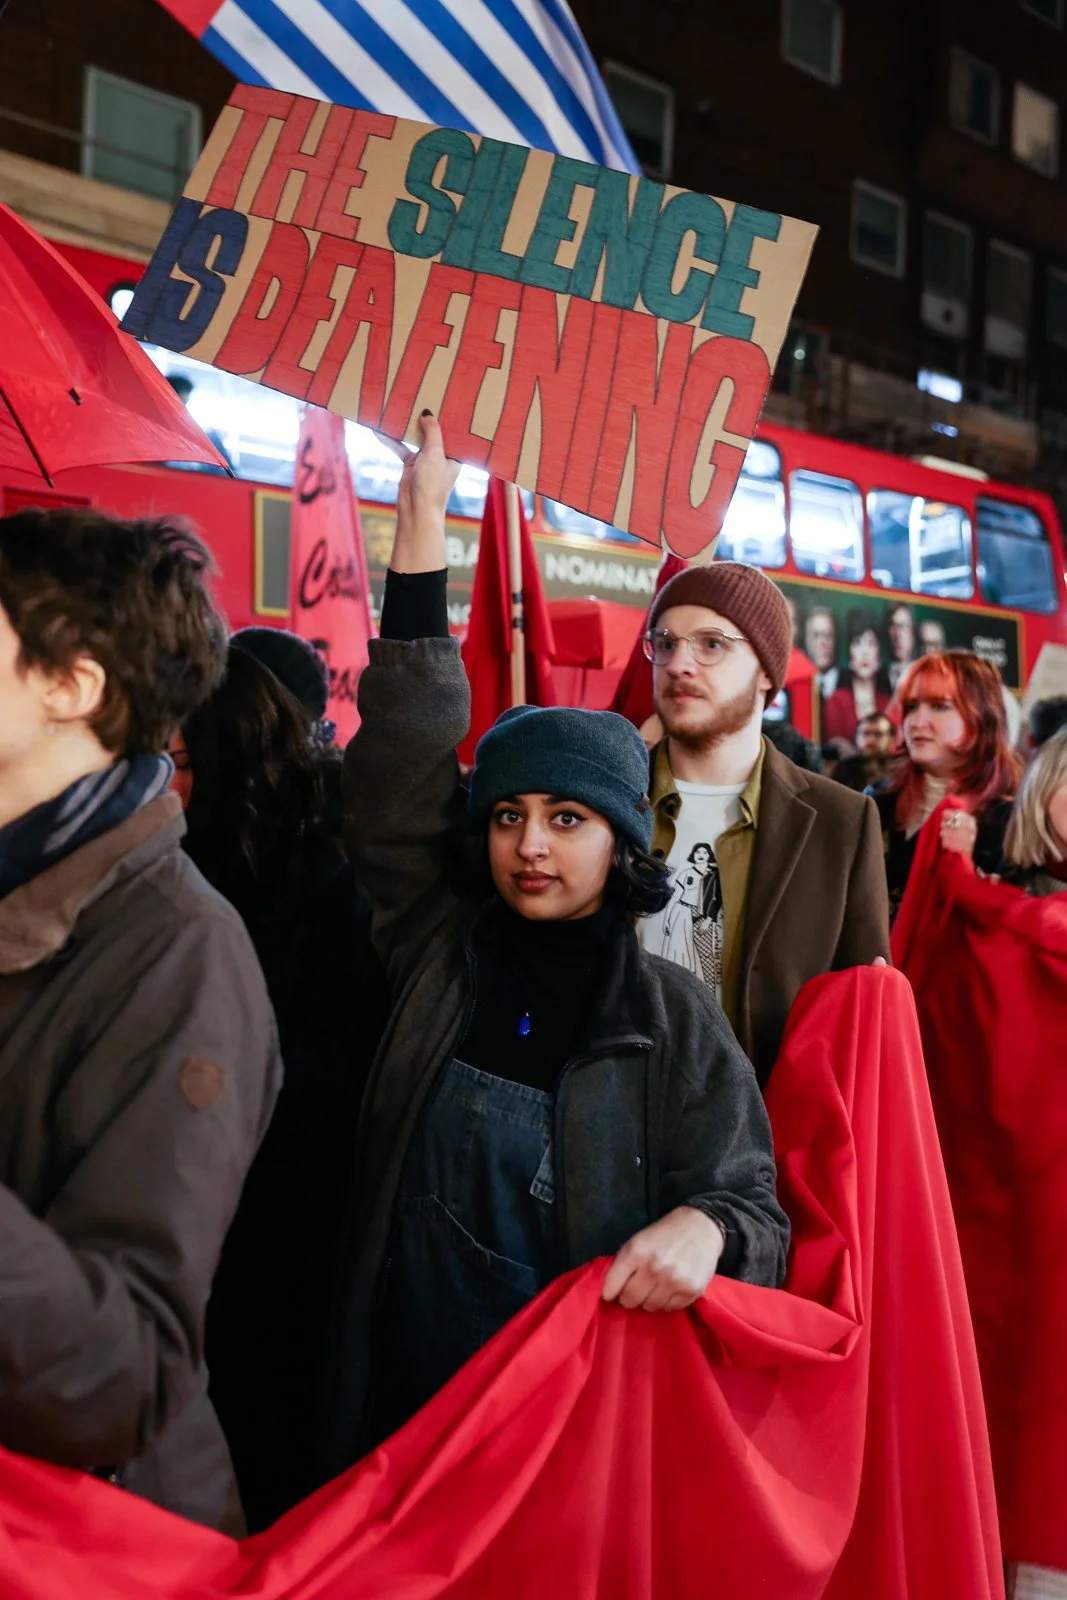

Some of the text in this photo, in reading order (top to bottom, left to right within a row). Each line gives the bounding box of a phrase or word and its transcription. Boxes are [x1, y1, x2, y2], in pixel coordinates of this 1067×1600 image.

[207, 83, 782, 339] THE SILENCE
[119, 197, 771, 558] IS DEAFENING
